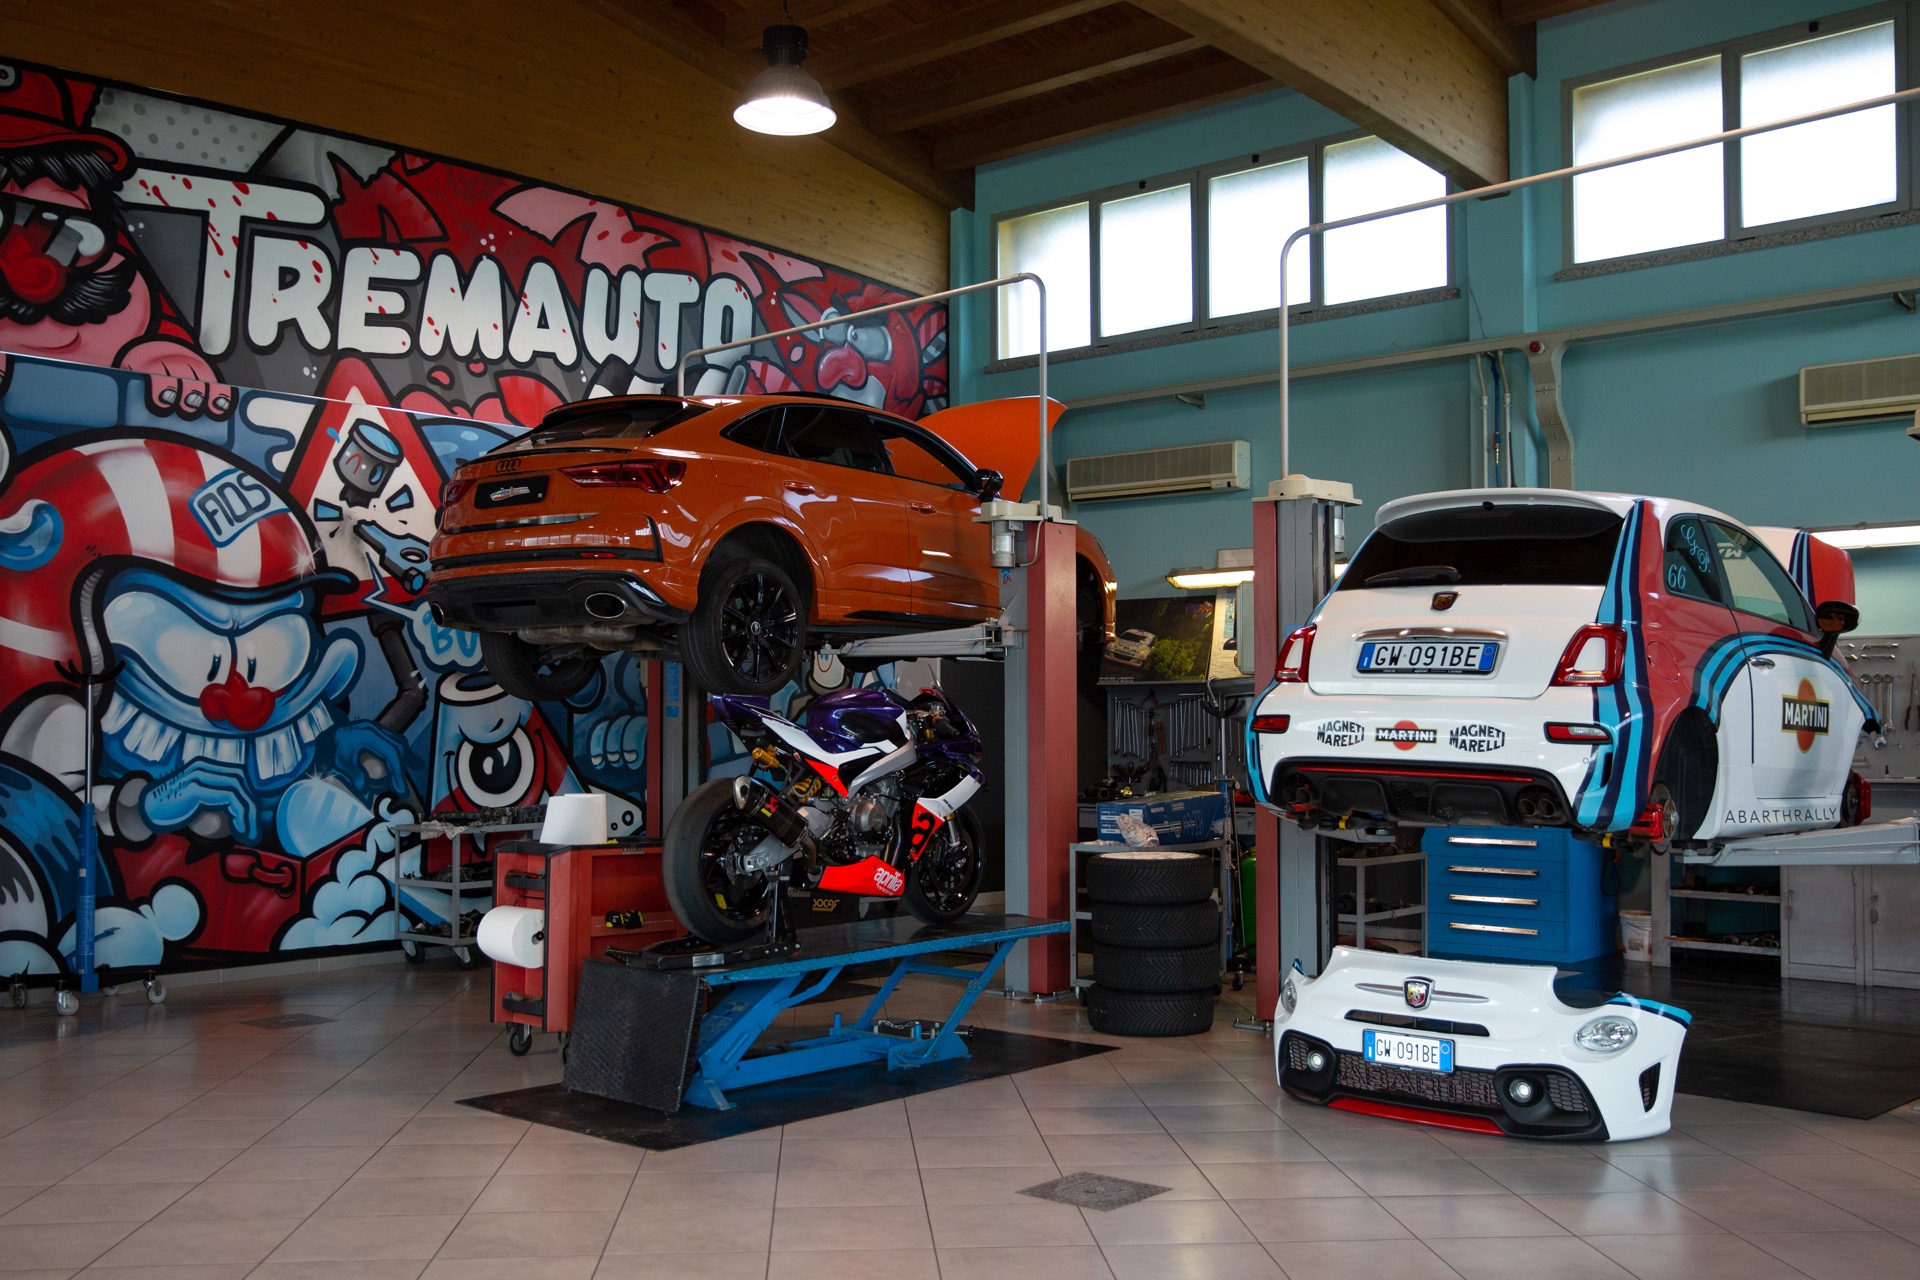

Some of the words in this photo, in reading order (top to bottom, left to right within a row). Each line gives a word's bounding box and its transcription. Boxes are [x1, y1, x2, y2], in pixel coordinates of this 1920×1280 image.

[120, 167, 753, 371] TREMAUTO
[1667, 563, 1687, 589] 66
[1374, 645, 1403, 667] GW
[1408, 645, 1480, 667] 091BE
[1784, 702, 1828, 729] MARTINI
[1317, 719, 1365, 737] MAGNETI
[1378, 729, 1434, 742] MARTINI
[1449, 723, 1506, 741] MAGNETI
[1316, 732, 1365, 747] MARELLI
[1449, 737, 1506, 753] MARELLI
[1724, 807, 1837, 824] ABARTHRALLY
[1376, 1038, 1391, 1058] GW
[1397, 1040, 1439, 1065] 091BE
